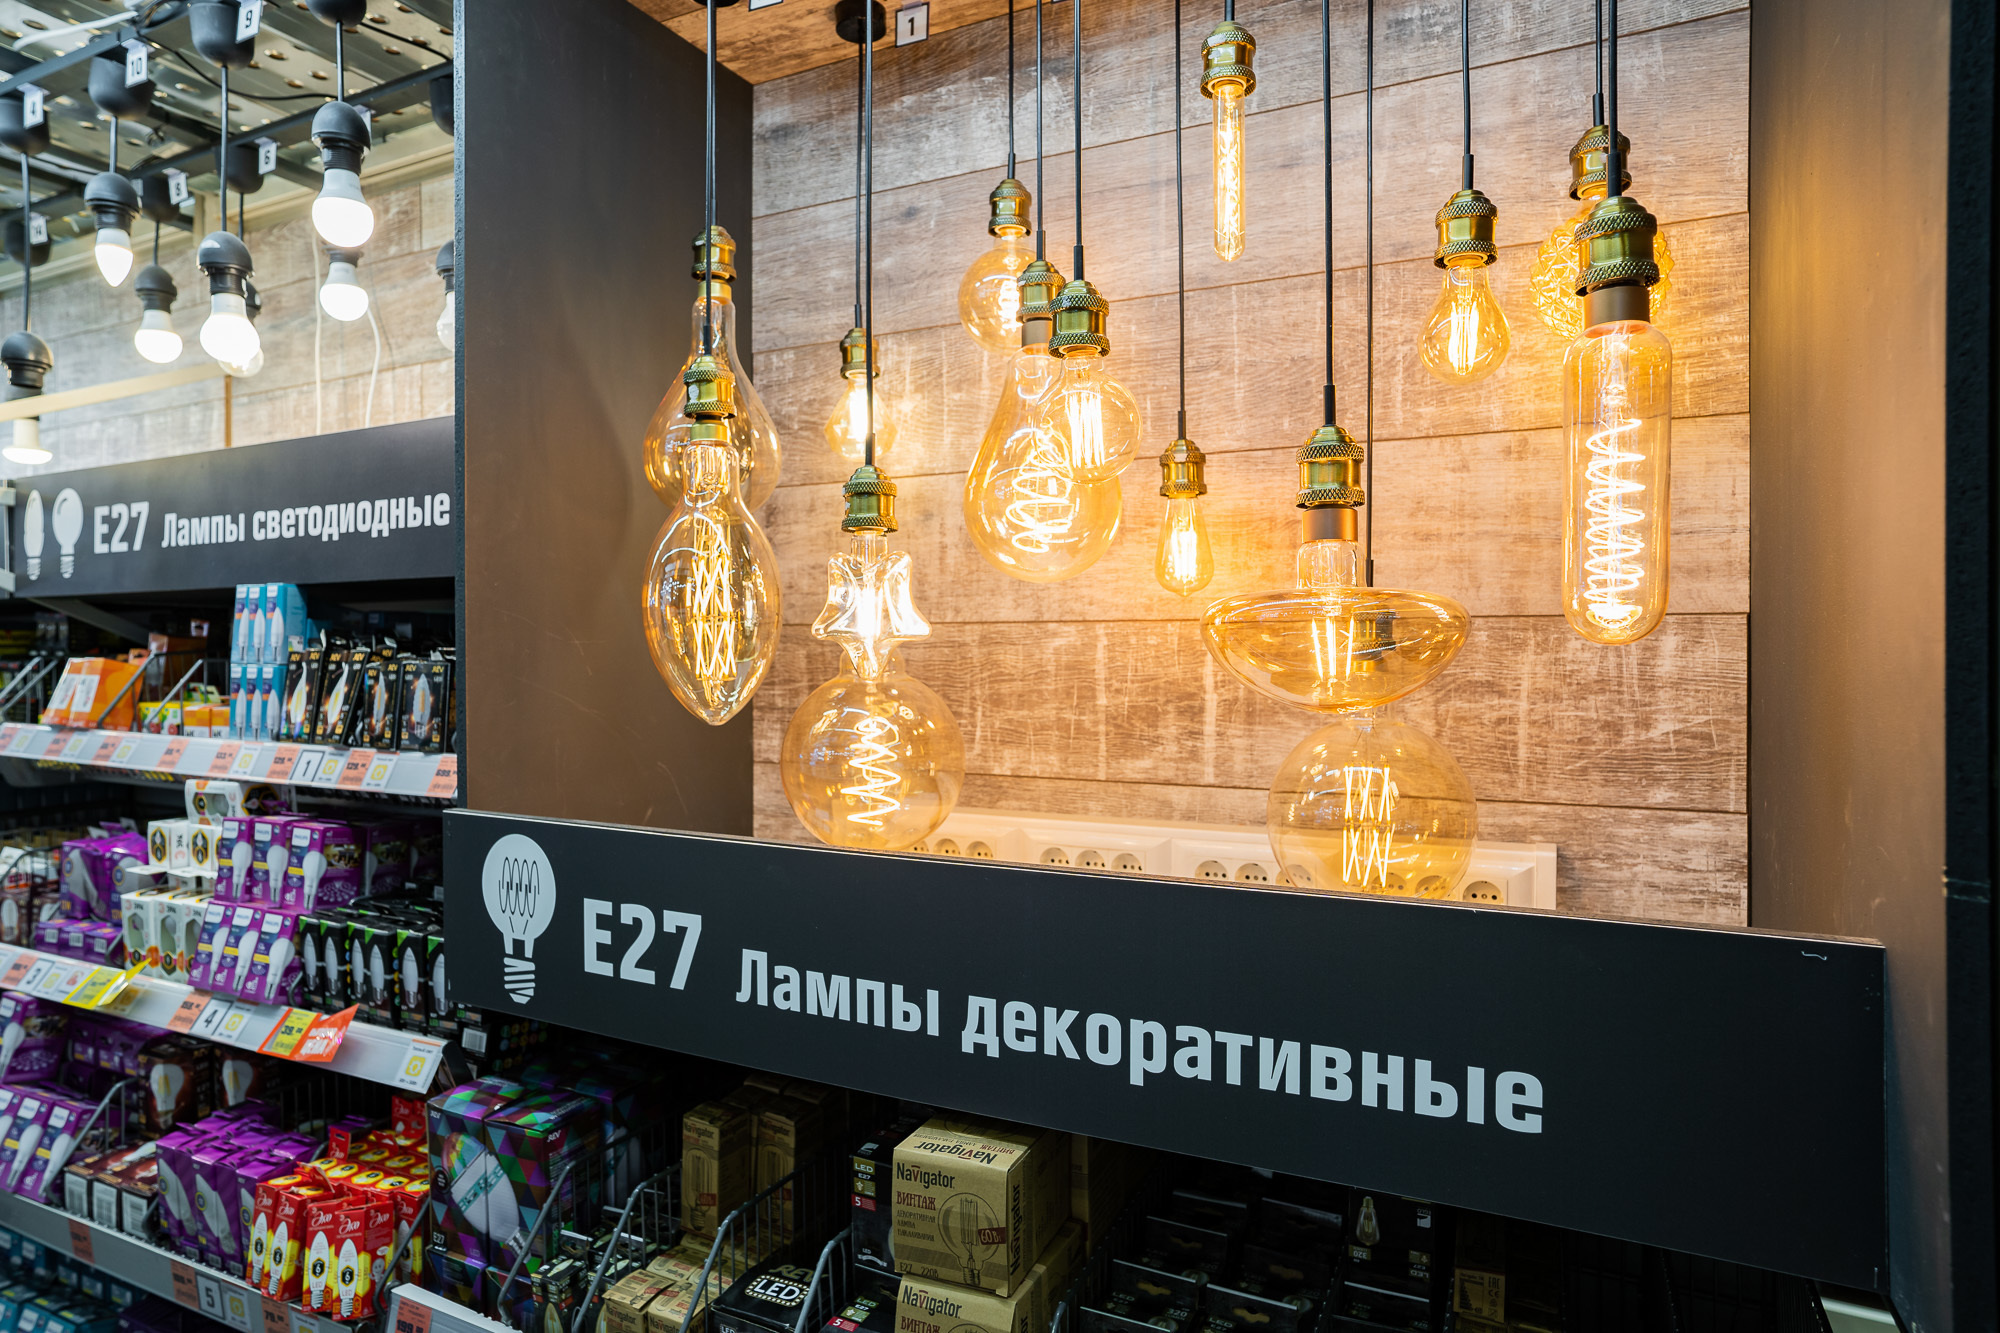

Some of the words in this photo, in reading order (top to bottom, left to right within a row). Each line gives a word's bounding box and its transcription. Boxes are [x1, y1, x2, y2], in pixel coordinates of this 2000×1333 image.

[245, 10, 254, 28] 9
[908, 16, 916, 36] 1
[131, 57, 143, 77] 10
[94, 501, 150, 554] E27
[161, 512, 246, 548] Лампы
[252, 492, 451, 542] светодиодные
[303, 760, 311, 777] 1
[204, 1010, 218, 1028] 4
[583, 897, 702, 990] E27
[735, 948, 940, 1037] Лампы
[961, 995, 1543, 1134] декоративные
[547, 1130, 562, 1142] REV
[684, 1123, 714, 1140] Navigator
[914, 1140, 997, 1165] Navigator
[855, 1163, 874, 1173] LED
[896, 1162, 956, 1189] Navigator
[855, 1196, 862, 1207] 5
[896, 1191, 936, 1211] ВИНТАЖ
[1010, 1184, 1023, 1276] Navigator
[315, 1263, 321, 1275] 6
[900, 1262, 913, 1273] E27
[1410, 1269, 1430, 1279] LED
[344, 1271, 351, 1282] 6
[205, 1287, 215, 1308] 5
[754, 1279, 801, 1301] LED
[857, 1297, 877, 1308] LED
[902, 1285, 962, 1319] Navigator
[1167, 1307, 1188, 1317] 320
[833, 1318, 842, 1327] 5
[901, 1316, 941, 1333] ВИНТАЖ
